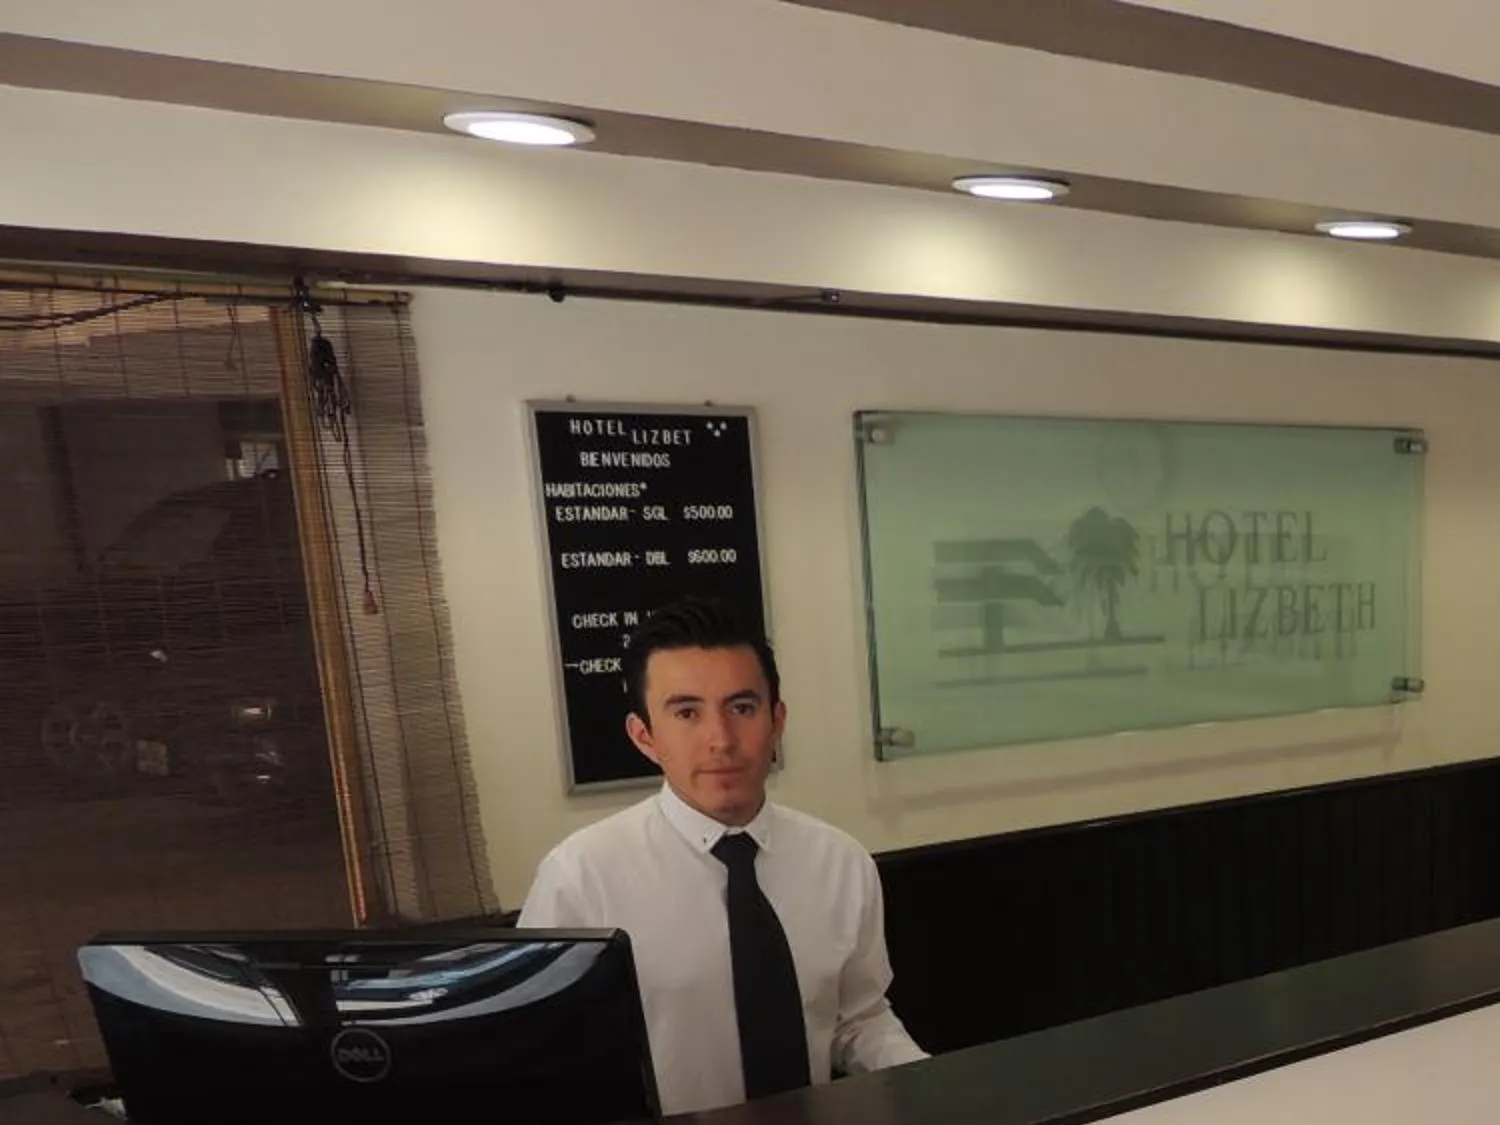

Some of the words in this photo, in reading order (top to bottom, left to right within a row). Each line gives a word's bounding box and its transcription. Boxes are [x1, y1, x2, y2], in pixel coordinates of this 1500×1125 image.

[569, 419, 627, 436] HOTEL
[632, 429, 693, 445] LIZBET
[1164, 509, 1329, 567] HOTEL
[572, 612, 618, 629] CHECK
[1198, 581, 1376, 643] LIZBETH
